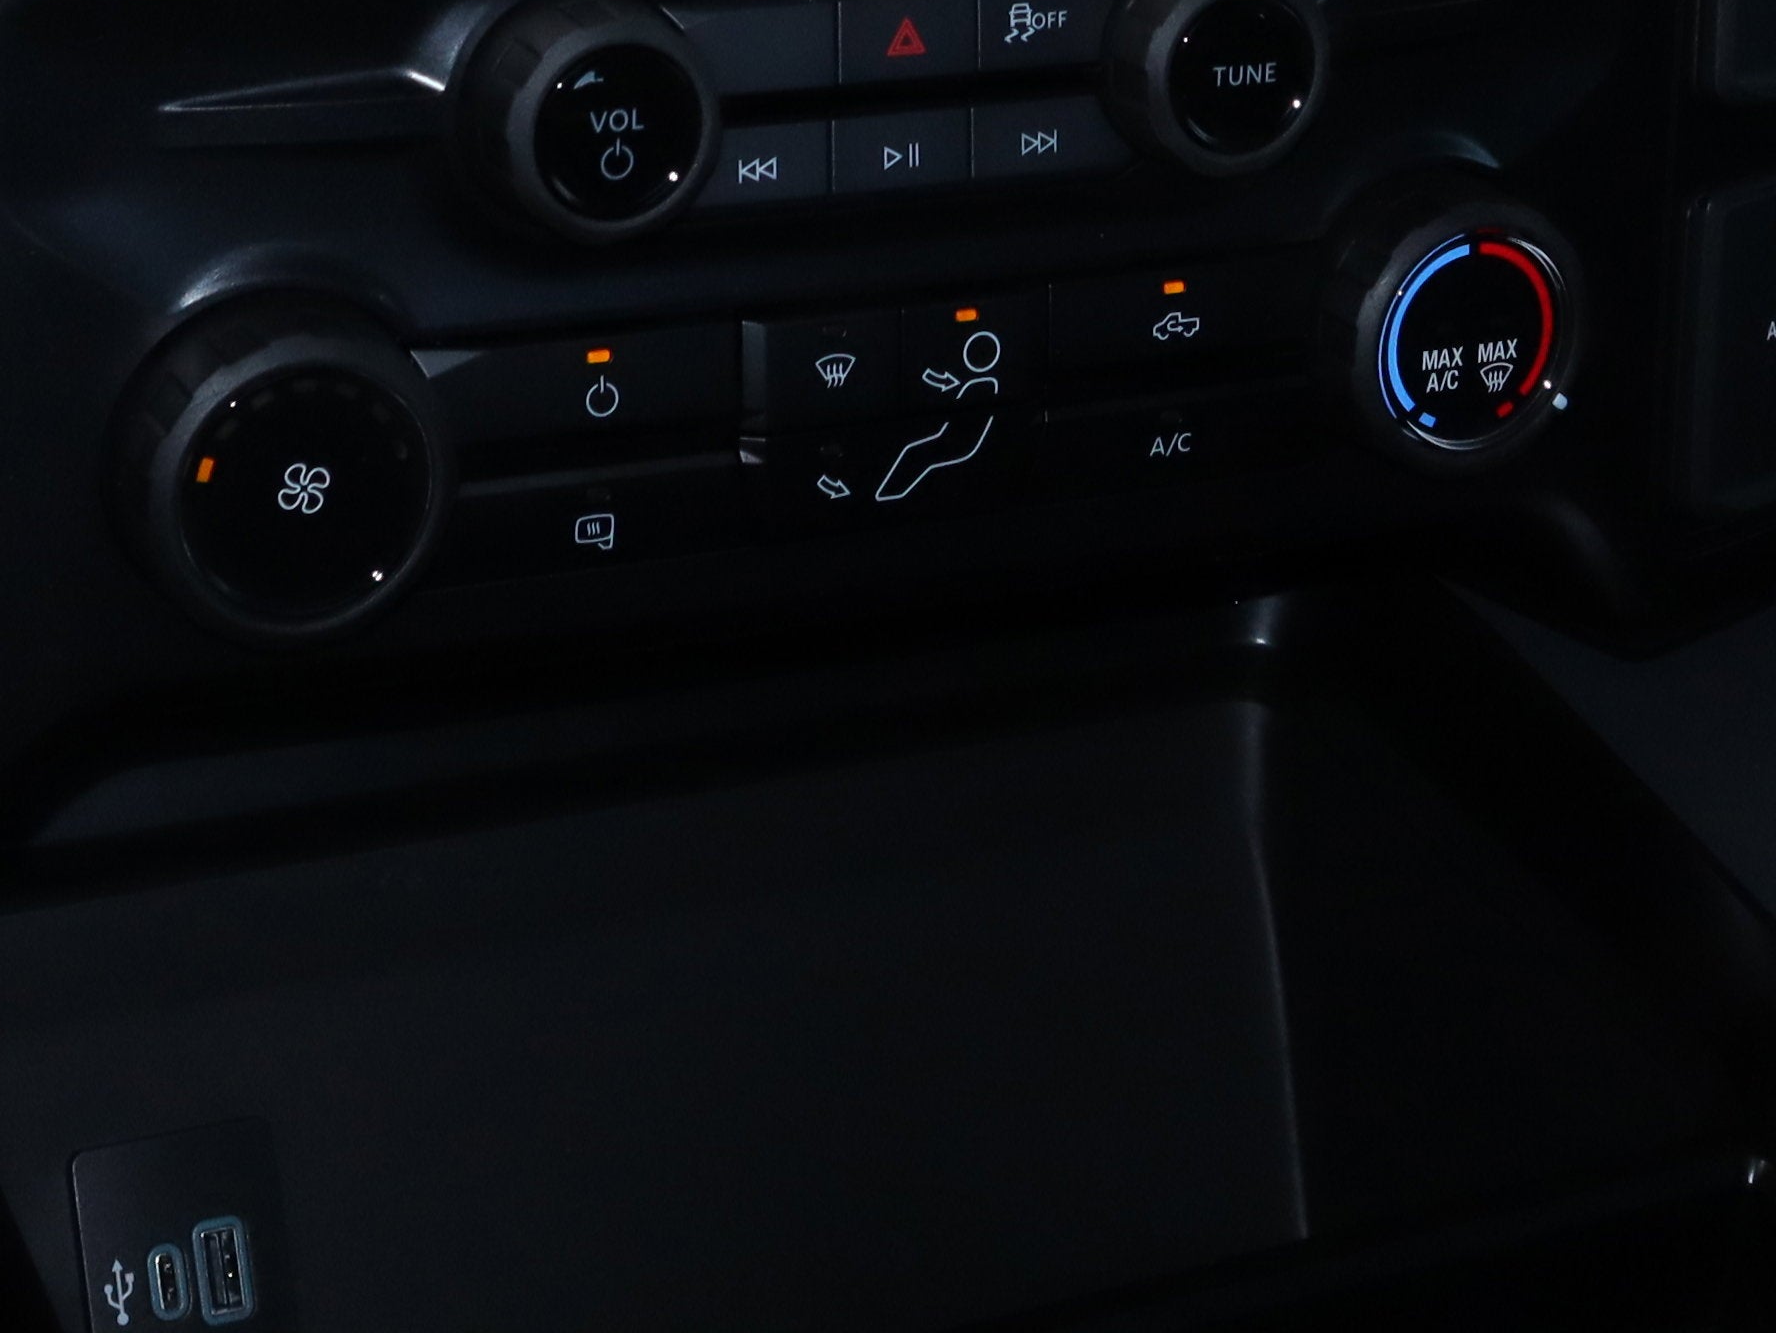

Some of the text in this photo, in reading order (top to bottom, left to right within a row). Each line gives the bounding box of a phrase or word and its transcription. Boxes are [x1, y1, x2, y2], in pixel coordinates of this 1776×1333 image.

[1032, 9, 1068, 31] OFF
[1212, 63, 1278, 87] TUNE
[589, 109, 644, 132] VOL
[1422, 346, 1464, 373] MAX
[1476, 337, 1518, 364] MAX
[1425, 370, 1460, 394] A/C
[1149, 432, 1193, 457] A/C
